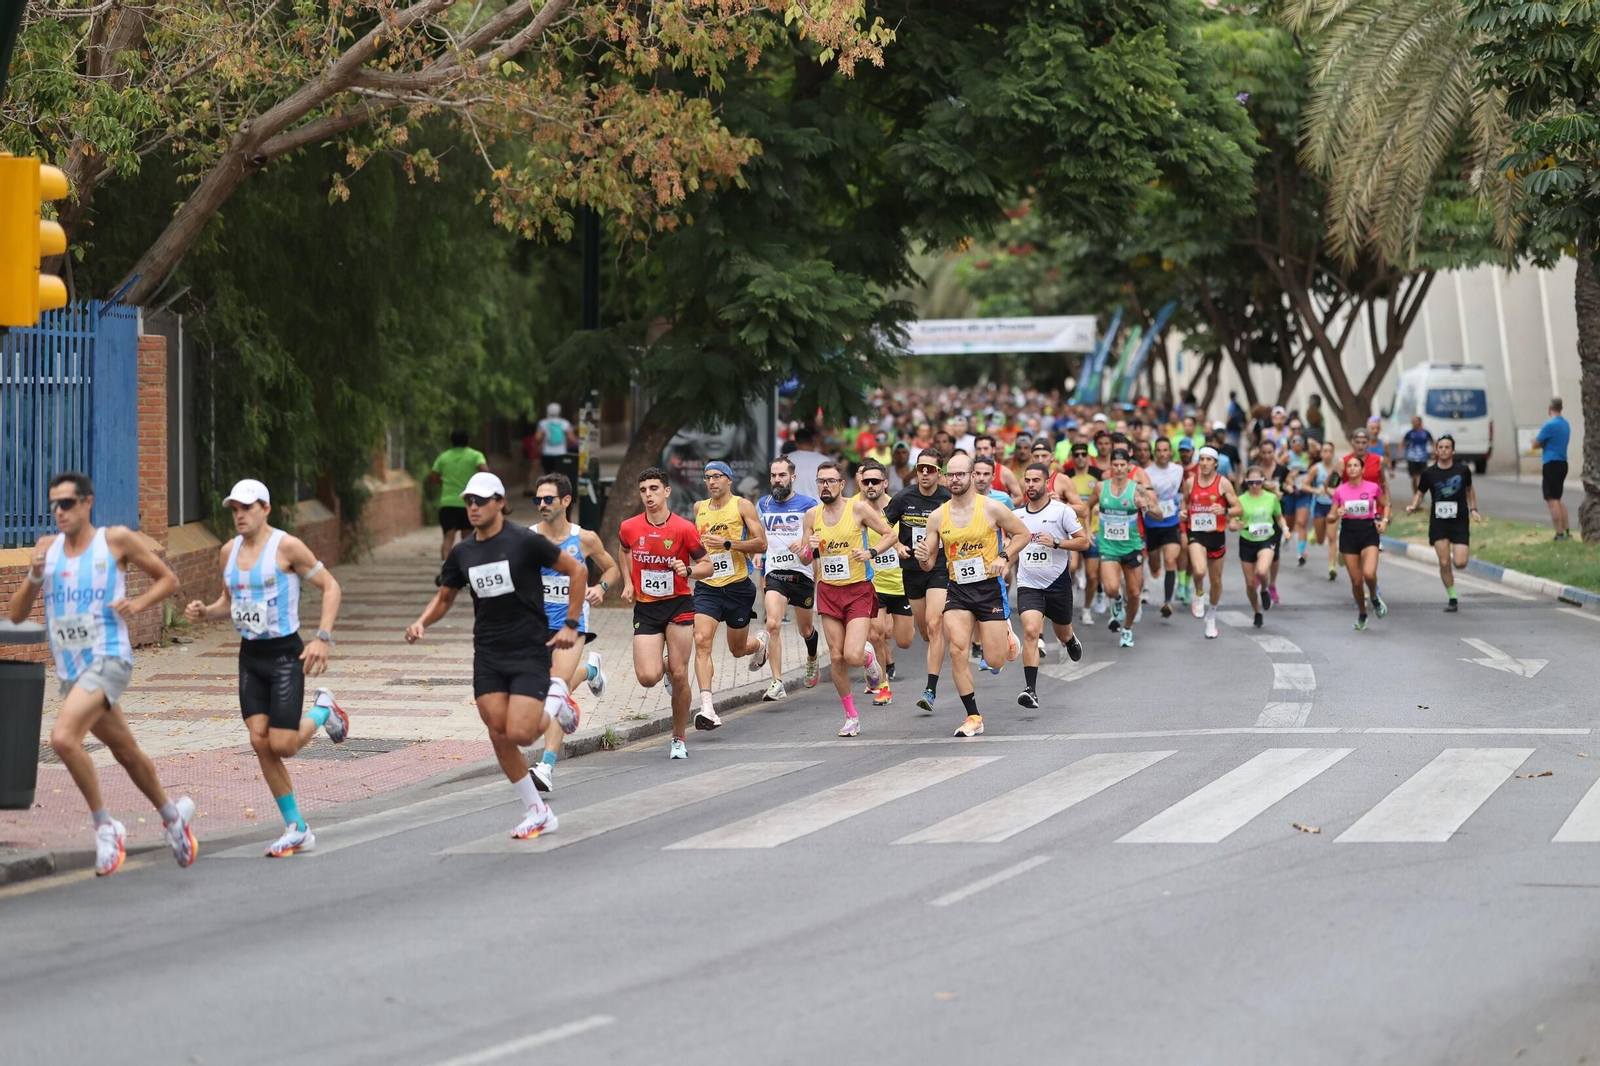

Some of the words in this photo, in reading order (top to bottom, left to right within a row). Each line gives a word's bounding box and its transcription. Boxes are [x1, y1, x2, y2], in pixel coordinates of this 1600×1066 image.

[827, 539, 849, 550] Álora
[960, 541, 984, 551] Álora
[772, 553, 795, 564] 1200
[875, 554, 896, 564] 885
[1026, 552, 1048, 561] 790
[713, 560, 728, 571] 96
[824, 563, 844, 573] 692
[960, 566, 976, 577] 33
[476, 574, 504, 589] 859
[645, 579, 667, 589] 241
[543, 585, 570, 596] 510
[235, 611, 260, 623] 344
[57, 626, 88, 641] 125
